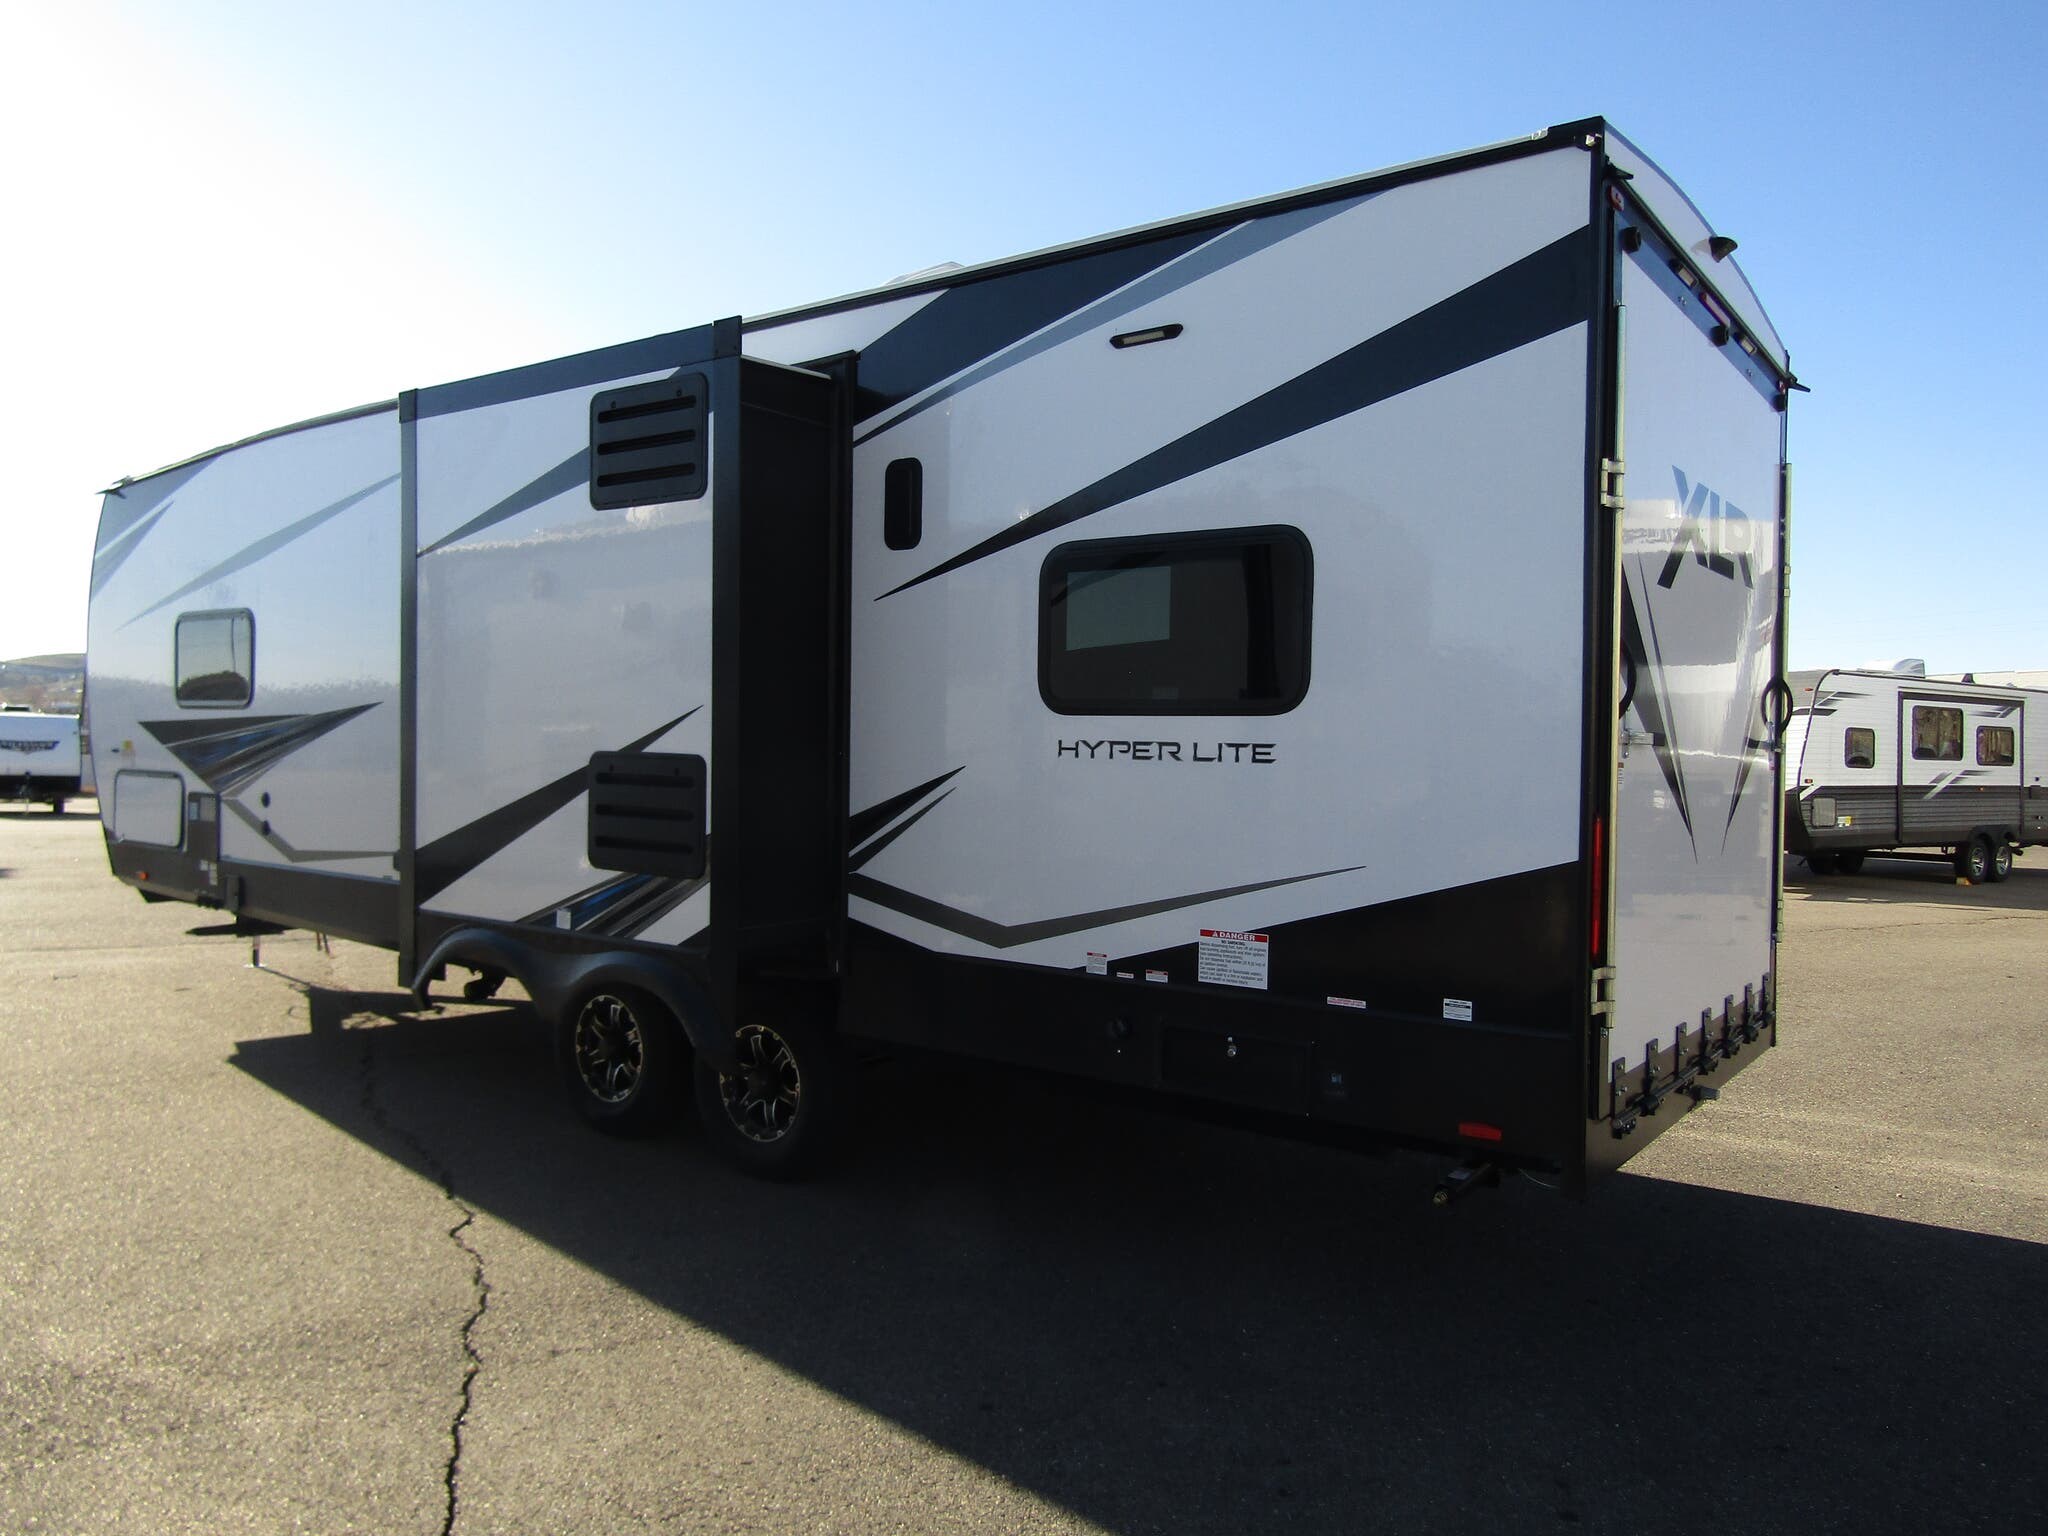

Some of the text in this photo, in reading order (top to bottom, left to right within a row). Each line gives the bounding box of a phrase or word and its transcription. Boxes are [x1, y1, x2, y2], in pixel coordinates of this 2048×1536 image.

[1058, 739, 1277, 764] HYPER LITE
[1219, 931, 1256, 941] DANGER
